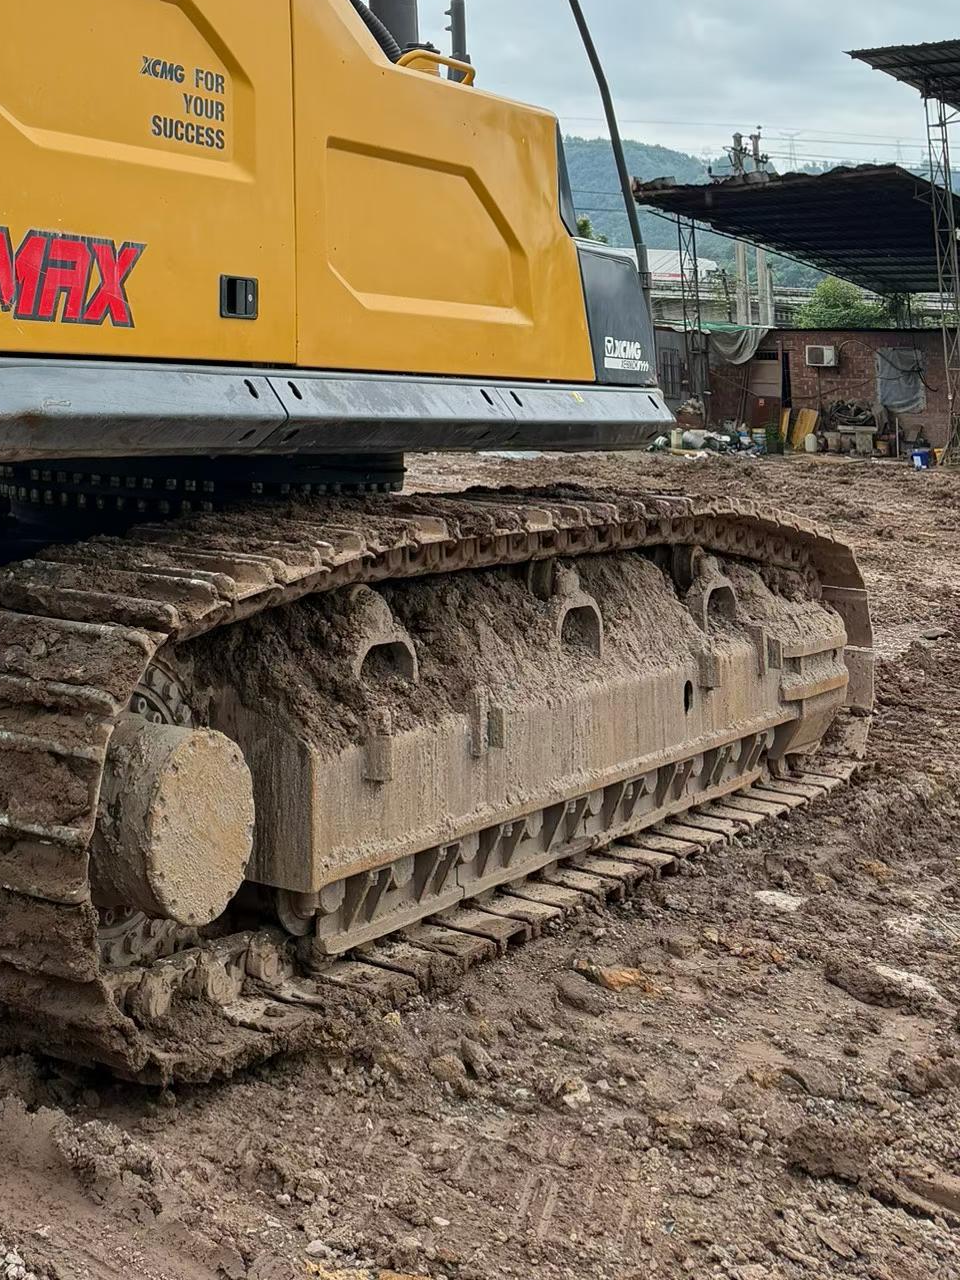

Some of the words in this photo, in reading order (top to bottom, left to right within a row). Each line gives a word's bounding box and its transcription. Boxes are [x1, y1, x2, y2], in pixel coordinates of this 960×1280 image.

[141, 56, 185, 83] XCMG
[195, 68, 225, 94] FOR
[183, 93, 225, 122] YOUR
[151, 115, 225, 150] SUCCESS
[614, 339, 641, 360] XCMG
